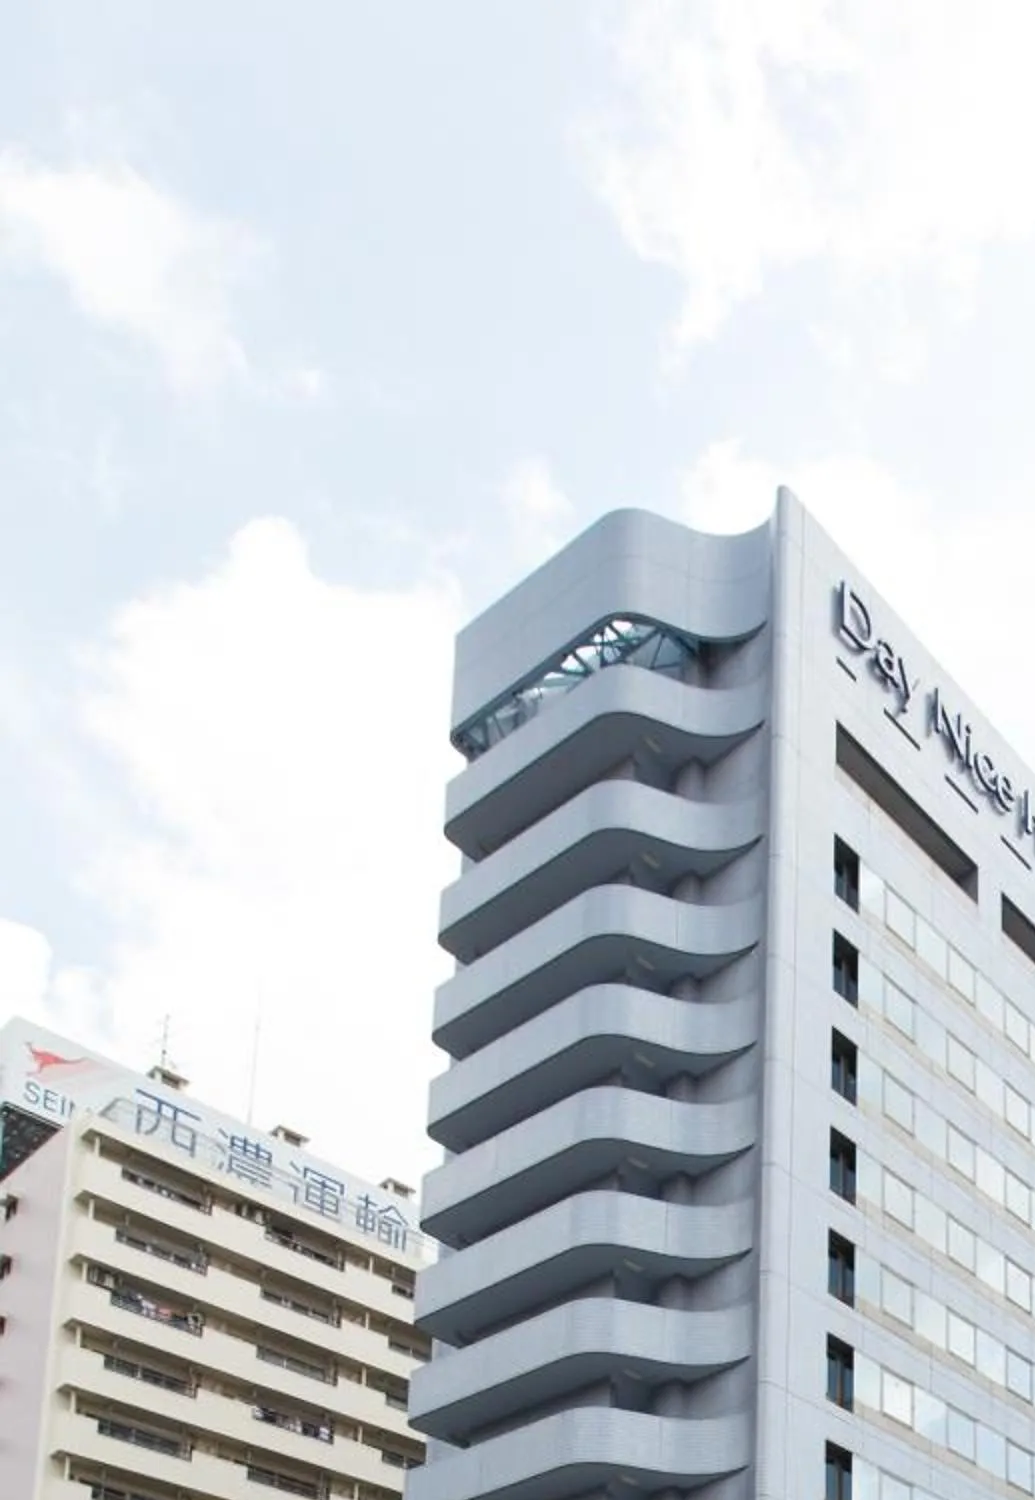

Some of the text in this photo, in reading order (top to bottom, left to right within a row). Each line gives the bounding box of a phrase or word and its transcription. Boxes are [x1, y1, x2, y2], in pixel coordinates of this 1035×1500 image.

[832, 579, 918, 713] Day
[927, 687, 1015, 814] Nice
[134, 1088, 410, 1253] 西濃運輸
